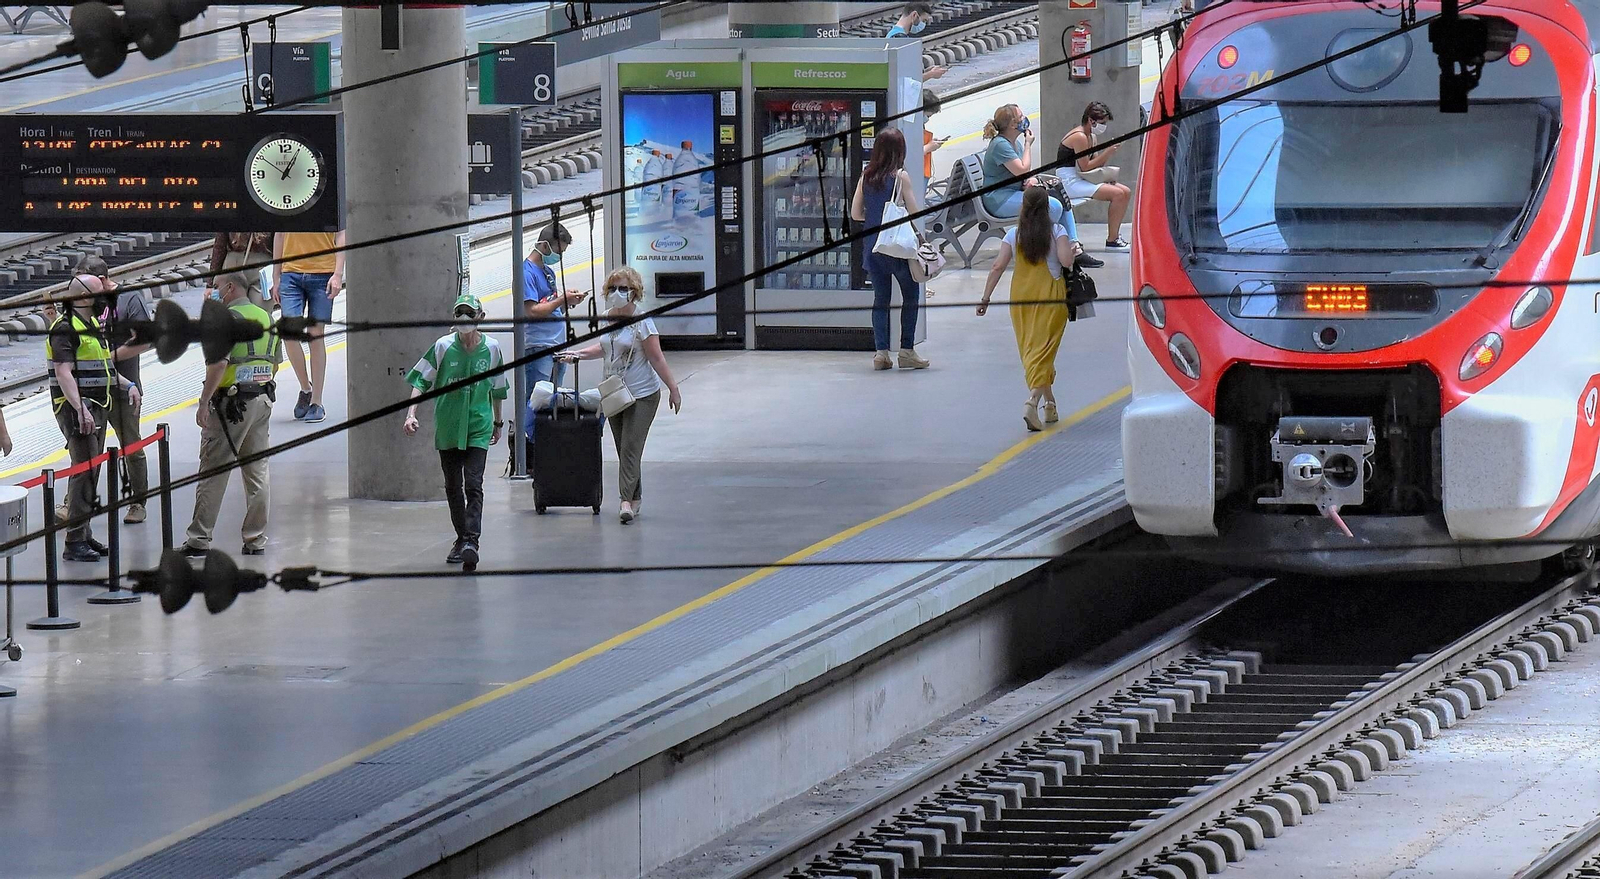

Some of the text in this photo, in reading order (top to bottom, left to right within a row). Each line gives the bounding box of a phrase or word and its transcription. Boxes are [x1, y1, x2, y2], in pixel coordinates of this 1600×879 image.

[665, 69, 696, 80] Agua
[793, 69, 847, 79] Refrescos
[533, 73, 551, 102] 8
[19, 126, 145, 138] Hora TIME Tren TRAIN
[277, 143, 293, 154] 12
[75, 167, 116, 175] DESTINATION
[256, 169, 266, 180] 9
[306, 168, 316, 178] 3
[282, 194, 292, 204] 6
